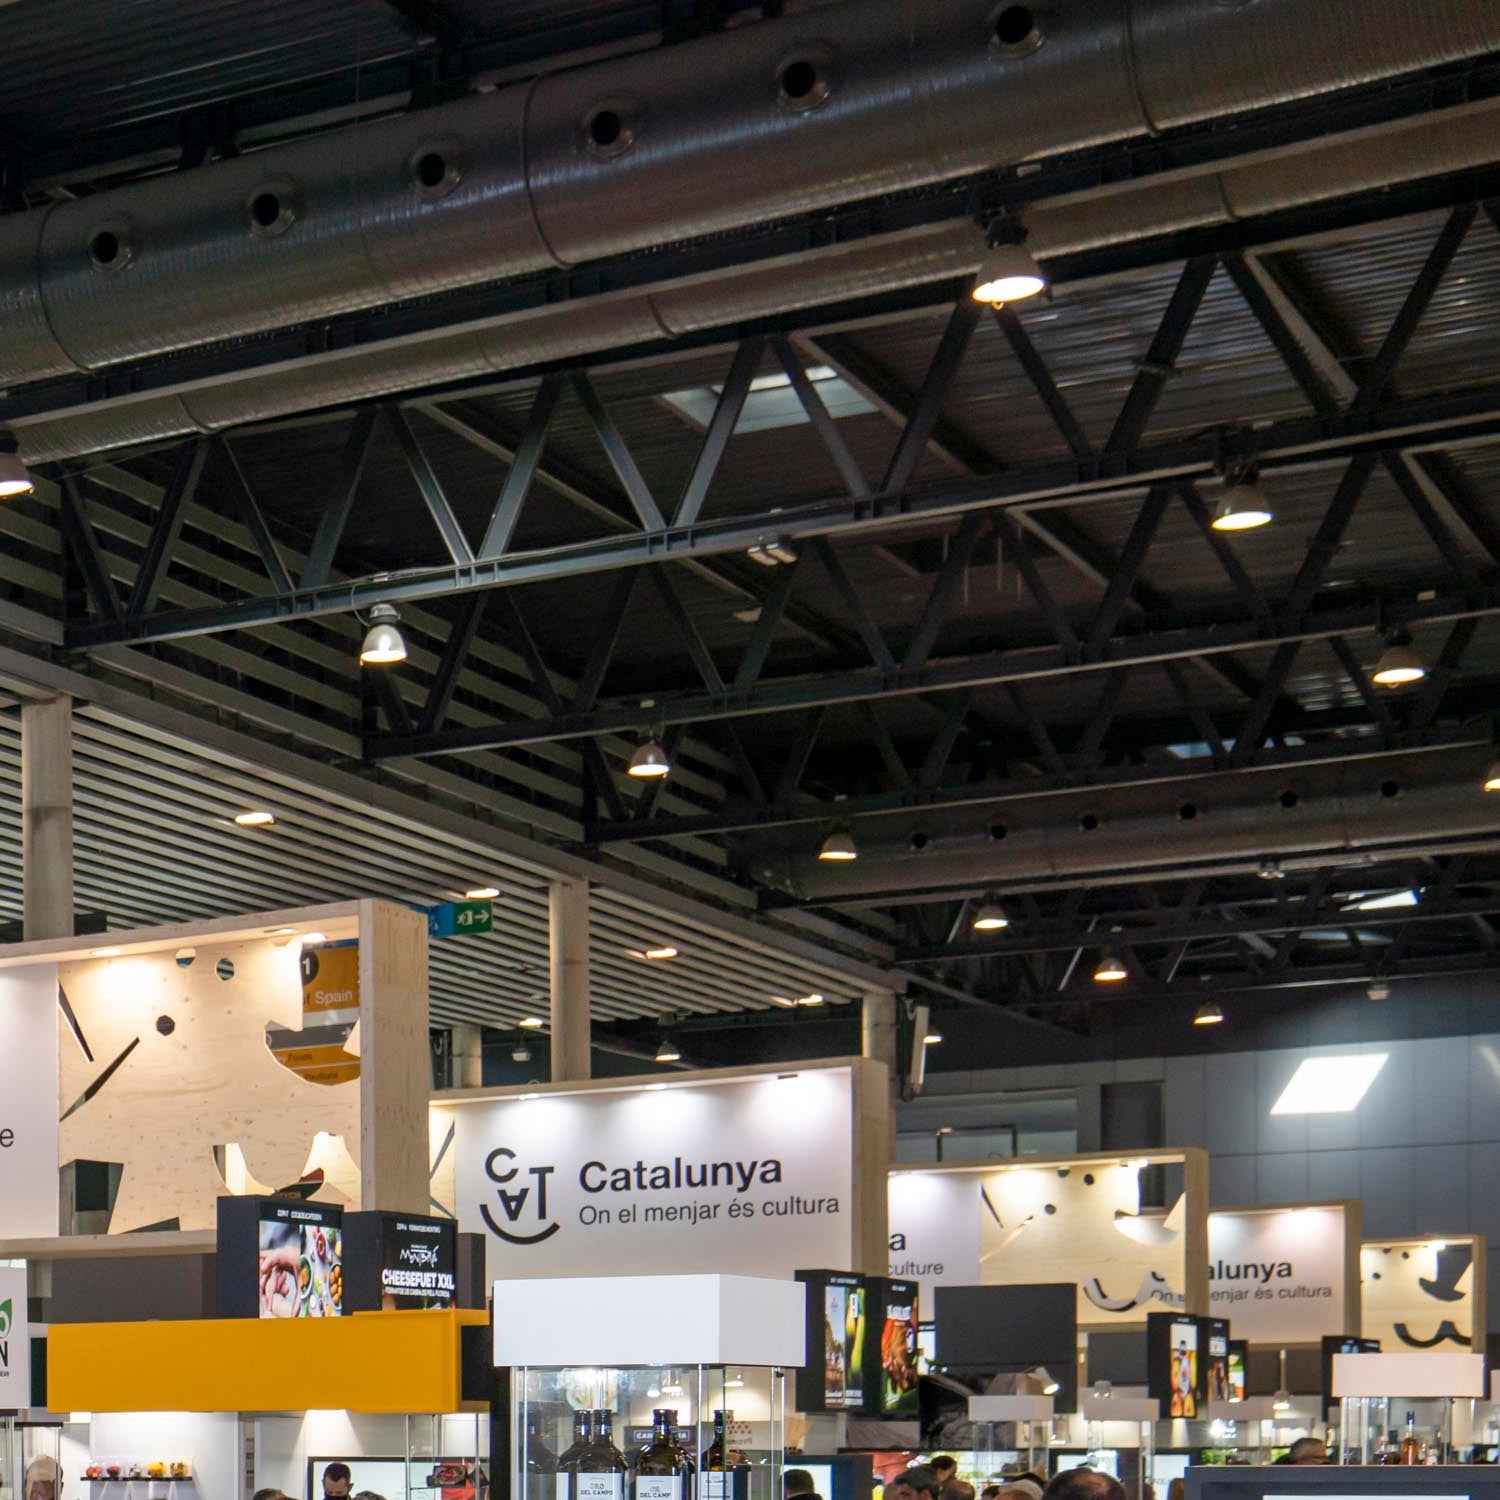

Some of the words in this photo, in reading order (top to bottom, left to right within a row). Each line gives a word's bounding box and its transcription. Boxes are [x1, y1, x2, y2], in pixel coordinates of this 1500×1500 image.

[315, 991, 353, 1006] Spain
[578, 1157, 782, 1193] Catalunya
[579, 1205, 610, 1226] On
[618, 1203, 636, 1224] el
[644, 1202, 720, 1225] menjar
[729, 1198, 755, 1218] és
[762, 1195, 840, 1217] cultura
[437, 1273, 456, 1290] XXL
[1208, 1259, 1293, 1283] alunya
[1211, 1287, 1249, 1304] enjar
[1278, 1284, 1332, 1299] cultura
